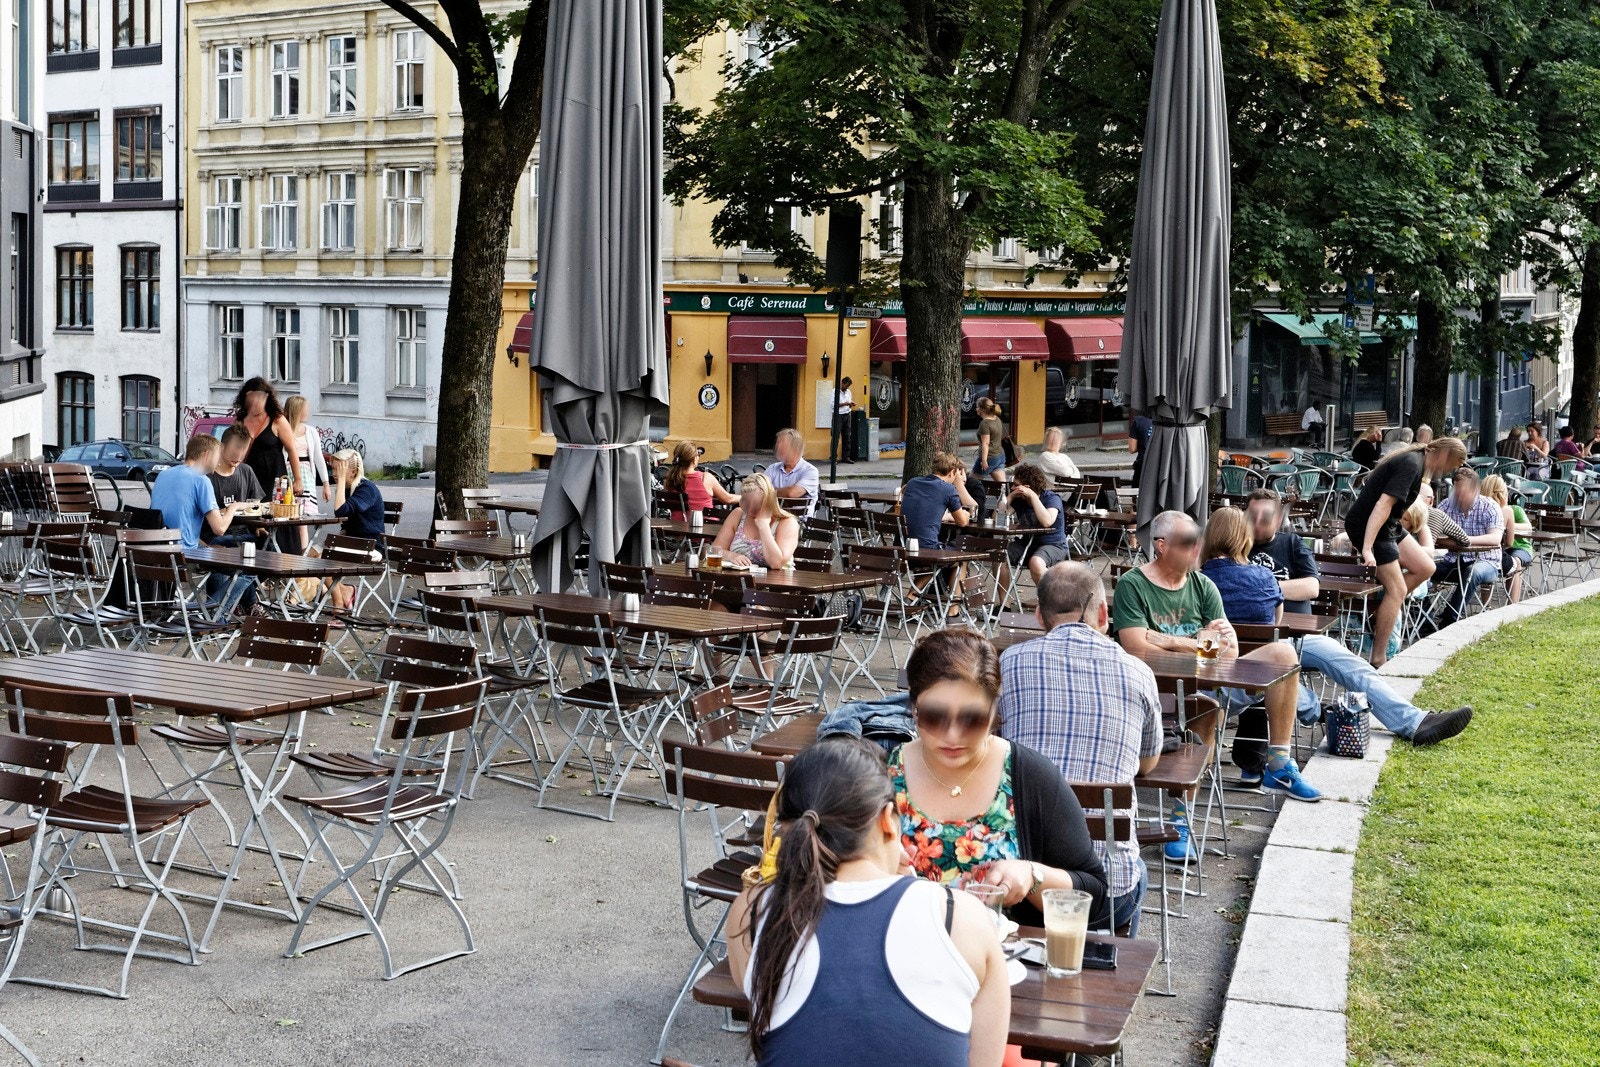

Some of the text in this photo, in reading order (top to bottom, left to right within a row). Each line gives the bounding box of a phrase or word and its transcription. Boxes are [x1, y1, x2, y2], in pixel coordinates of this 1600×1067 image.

[728, 296, 808, 311] Café Serenad
[853, 307, 877, 317] Automat
